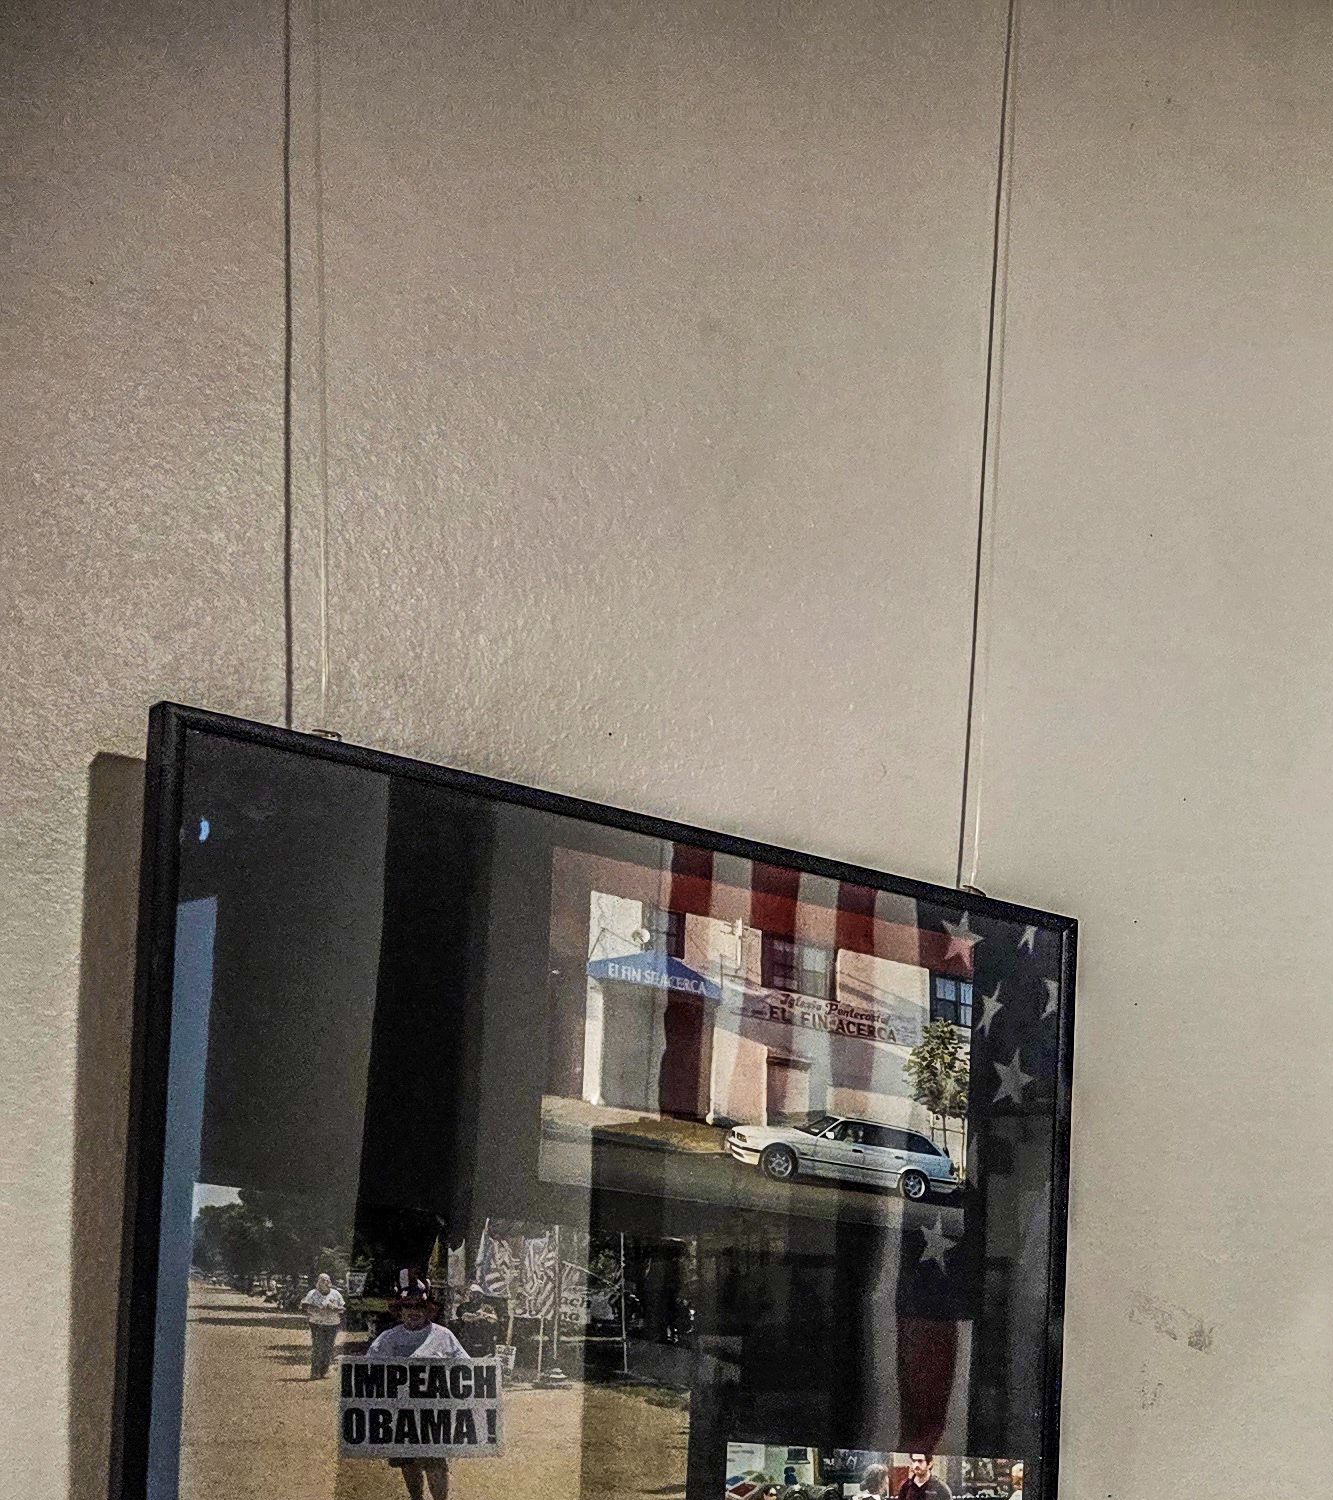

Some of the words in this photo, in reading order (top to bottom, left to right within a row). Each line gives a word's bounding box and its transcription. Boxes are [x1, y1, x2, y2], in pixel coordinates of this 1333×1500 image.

[621, 965, 641, 983] FIN
[770, 1005, 793, 1026] EL
[836, 1019, 897, 1042] ACERCA
[340, 1362, 497, 1400] IMPEACH
